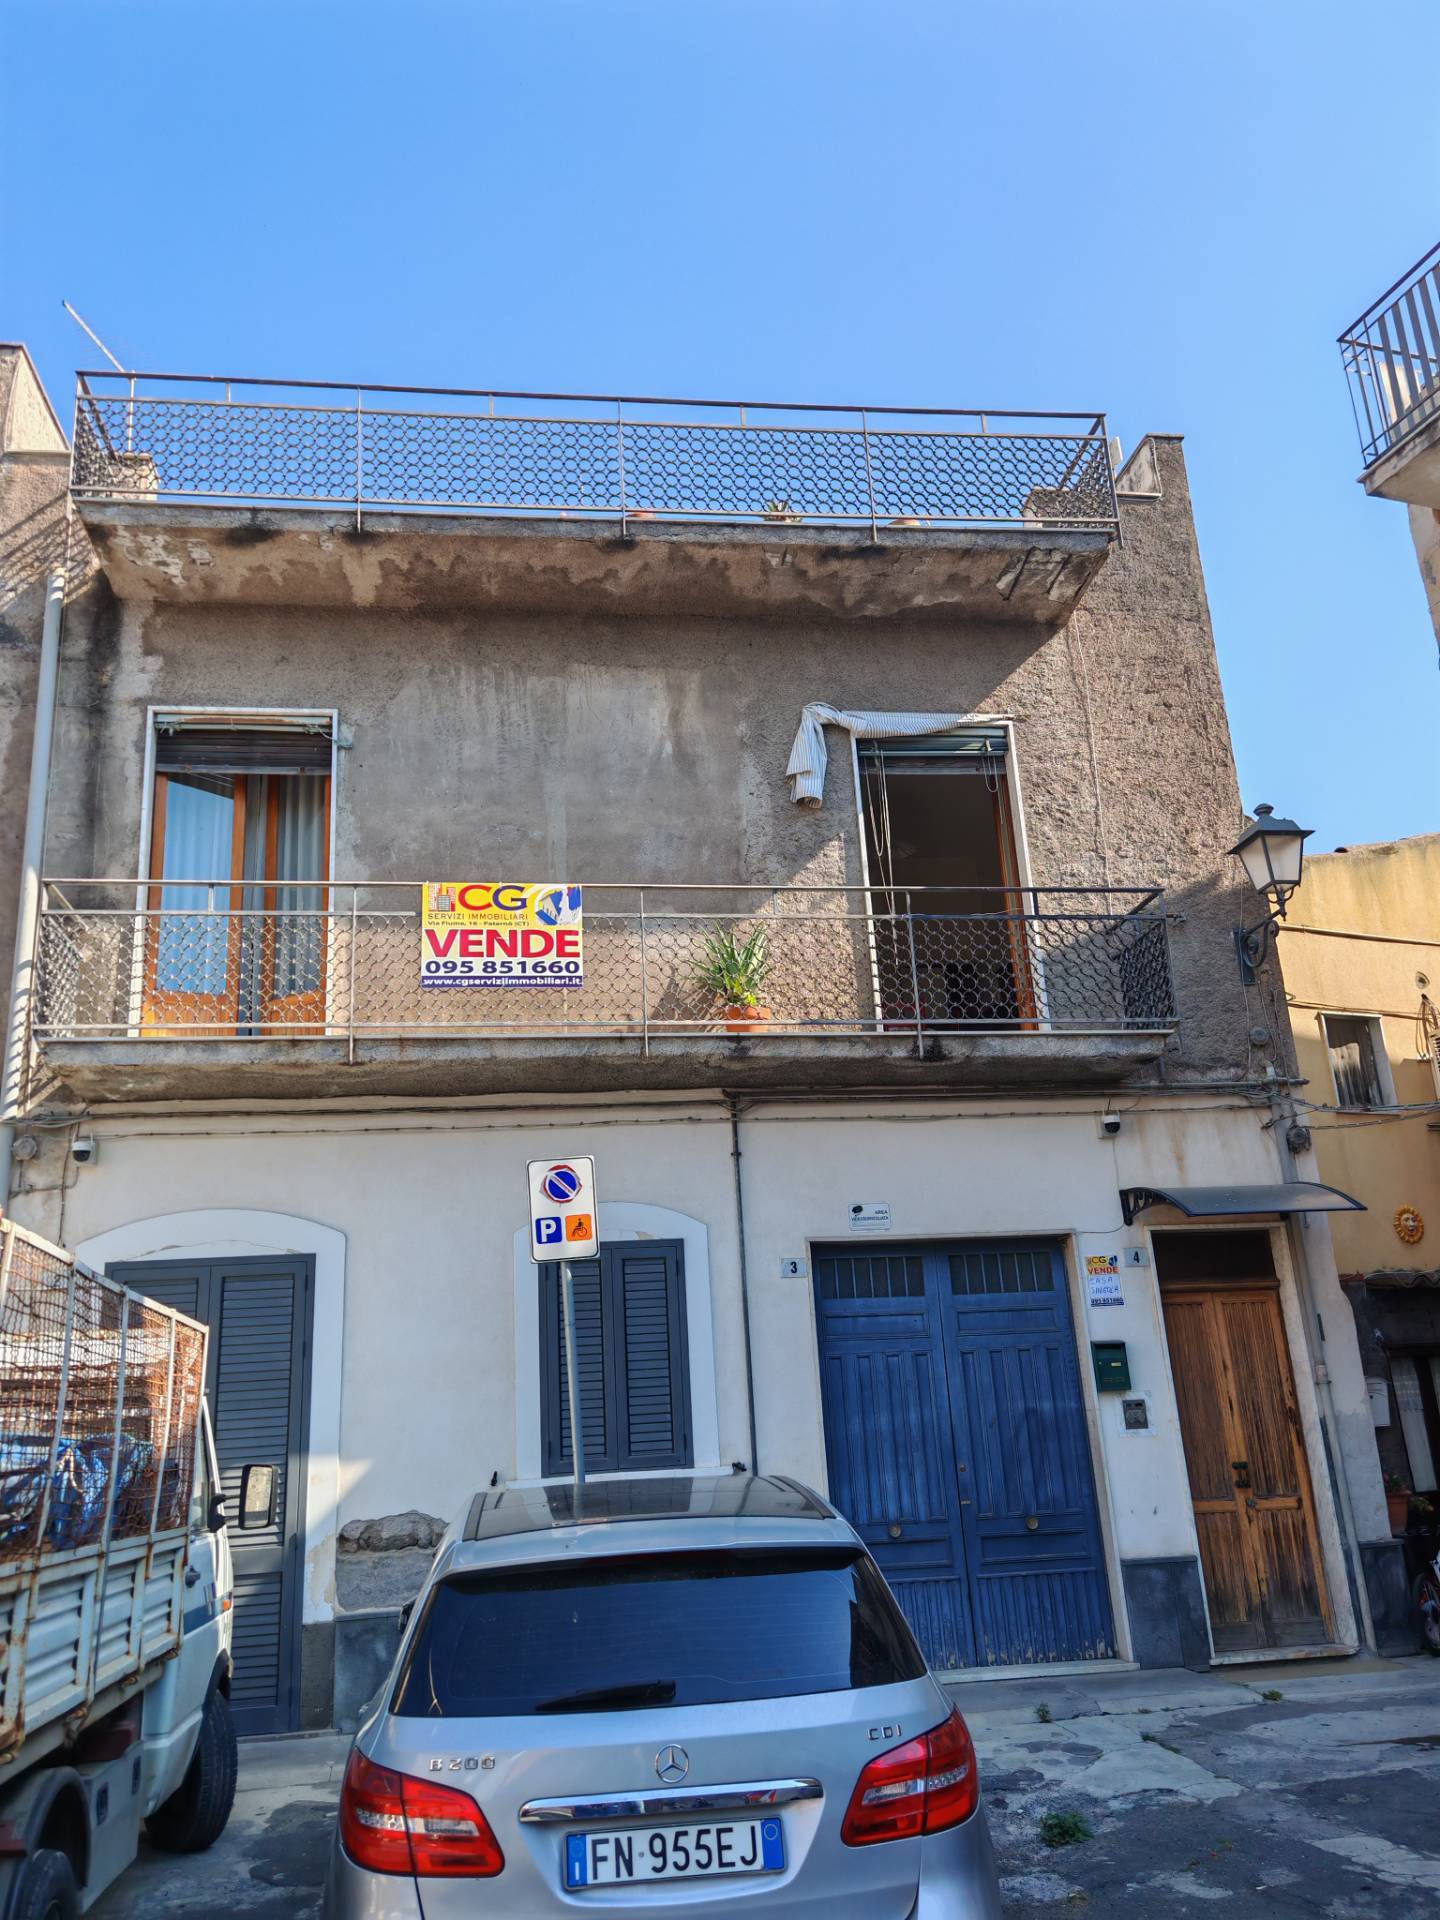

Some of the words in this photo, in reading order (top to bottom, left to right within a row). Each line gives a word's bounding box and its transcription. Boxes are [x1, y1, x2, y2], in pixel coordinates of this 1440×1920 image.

[458, 884, 528, 911] CG
[468, 913, 528, 921] IMMOBILIARI
[424, 929, 580, 958] VENDE
[425, 960, 474, 974] 095
[482, 960, 580, 974] 851660
[540, 1219, 557, 1243] P
[1091, 1256, 1107, 1264] CG
[1133, 1251, 1140, 1264] 4
[790, 1261, 798, 1274] 3
[1088, 1266, 1120, 1274] VENDE
[867, 1724, 902, 1741] CDI
